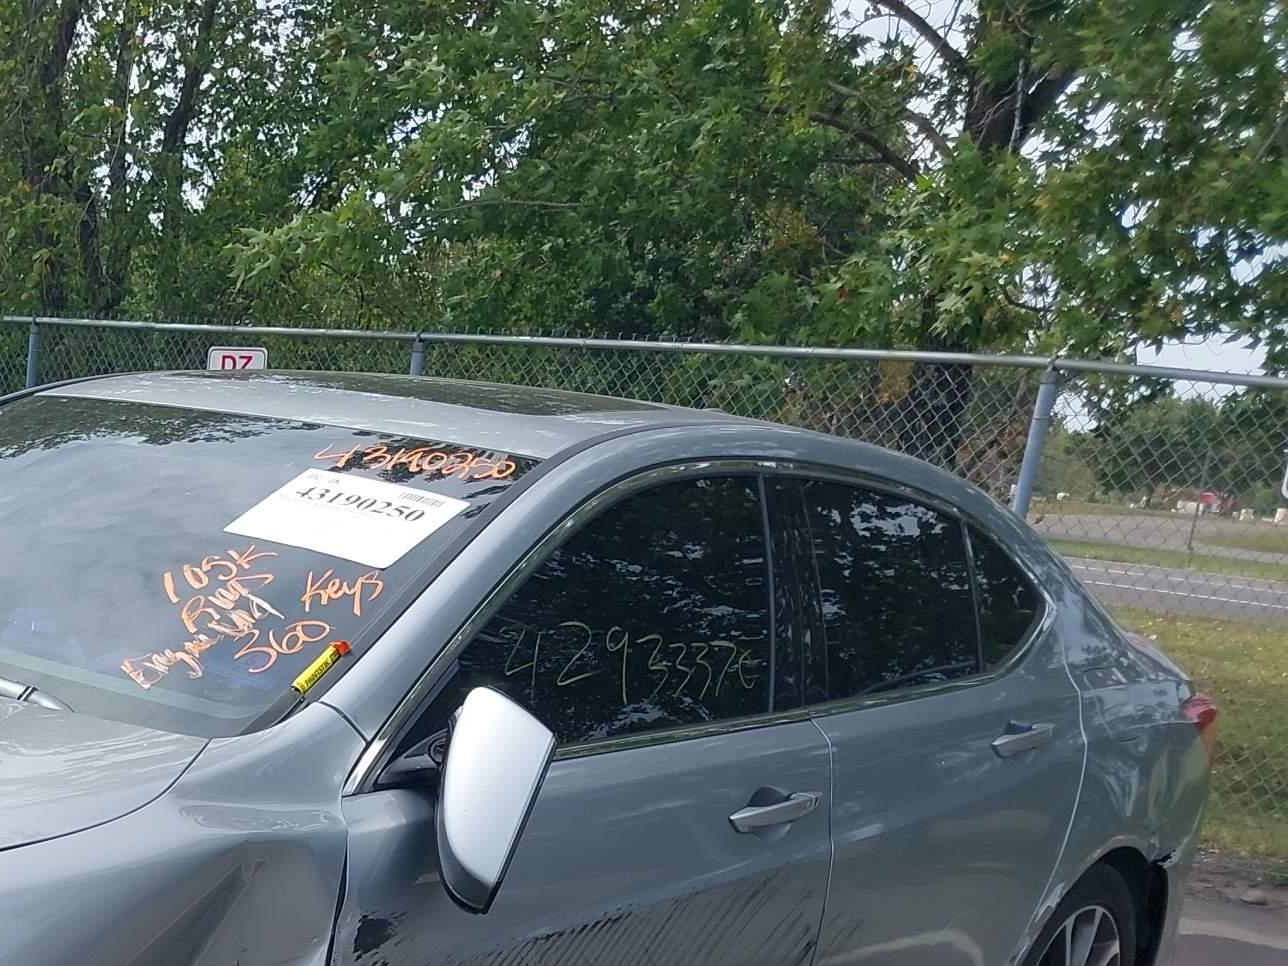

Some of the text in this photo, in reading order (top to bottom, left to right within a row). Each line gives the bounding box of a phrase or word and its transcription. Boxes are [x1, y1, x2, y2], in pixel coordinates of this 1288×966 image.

[314, 443, 516, 480] 43190250
[295, 486, 425, 523] 43190250
[300, 569, 384, 617] Keys
[233, 620, 334, 673] 360
